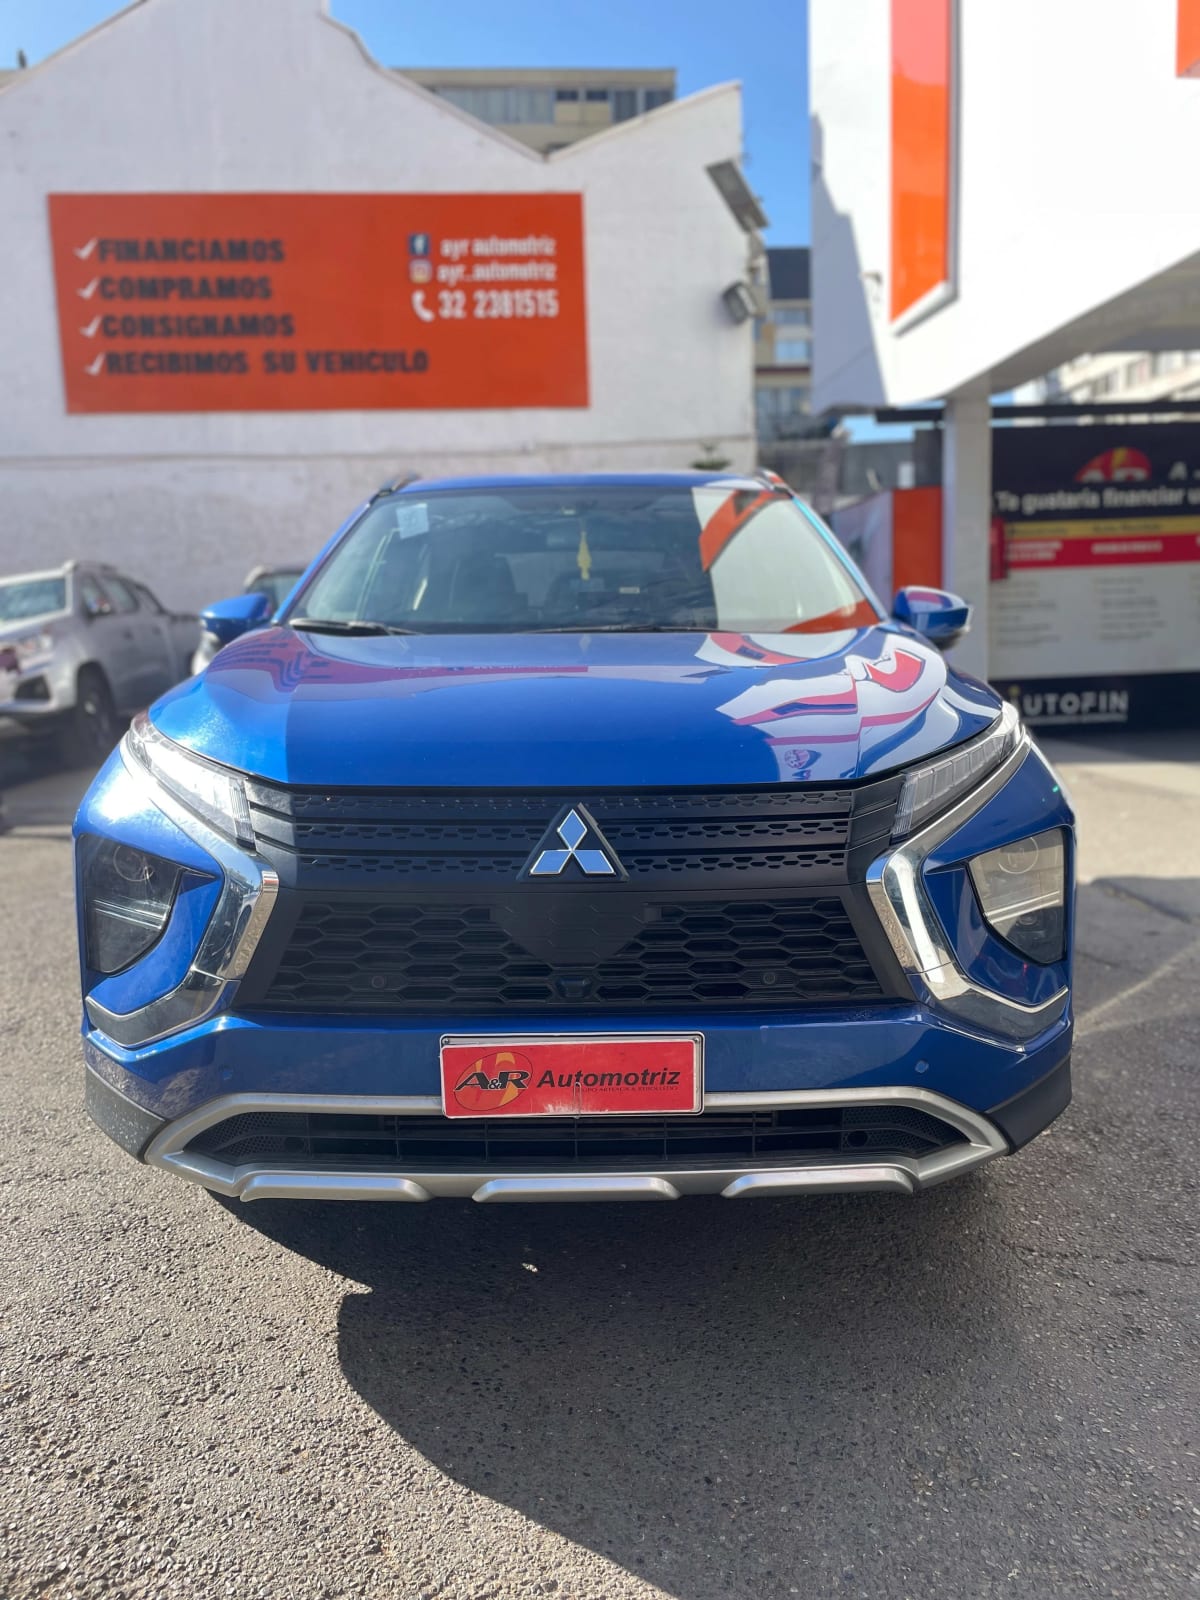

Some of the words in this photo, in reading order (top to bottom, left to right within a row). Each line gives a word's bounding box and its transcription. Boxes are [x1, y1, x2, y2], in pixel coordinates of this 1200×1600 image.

[99, 239, 284, 263] FINANCIAMOS
[441, 238, 469, 260] ayr
[473, 235, 556, 256] automotriz
[101, 276, 272, 299] COMPRAMOS
[438, 290, 466, 318] 32
[473, 288, 559, 318] 2381515
[103, 315, 295, 338] CONSIGNAMOS
[106, 352, 248, 374] RECIBIMOS
[263, 351, 295, 374] SU
[305, 351, 428, 373] VEHICULO
[537, 1067, 681, 1088] Automotriz
